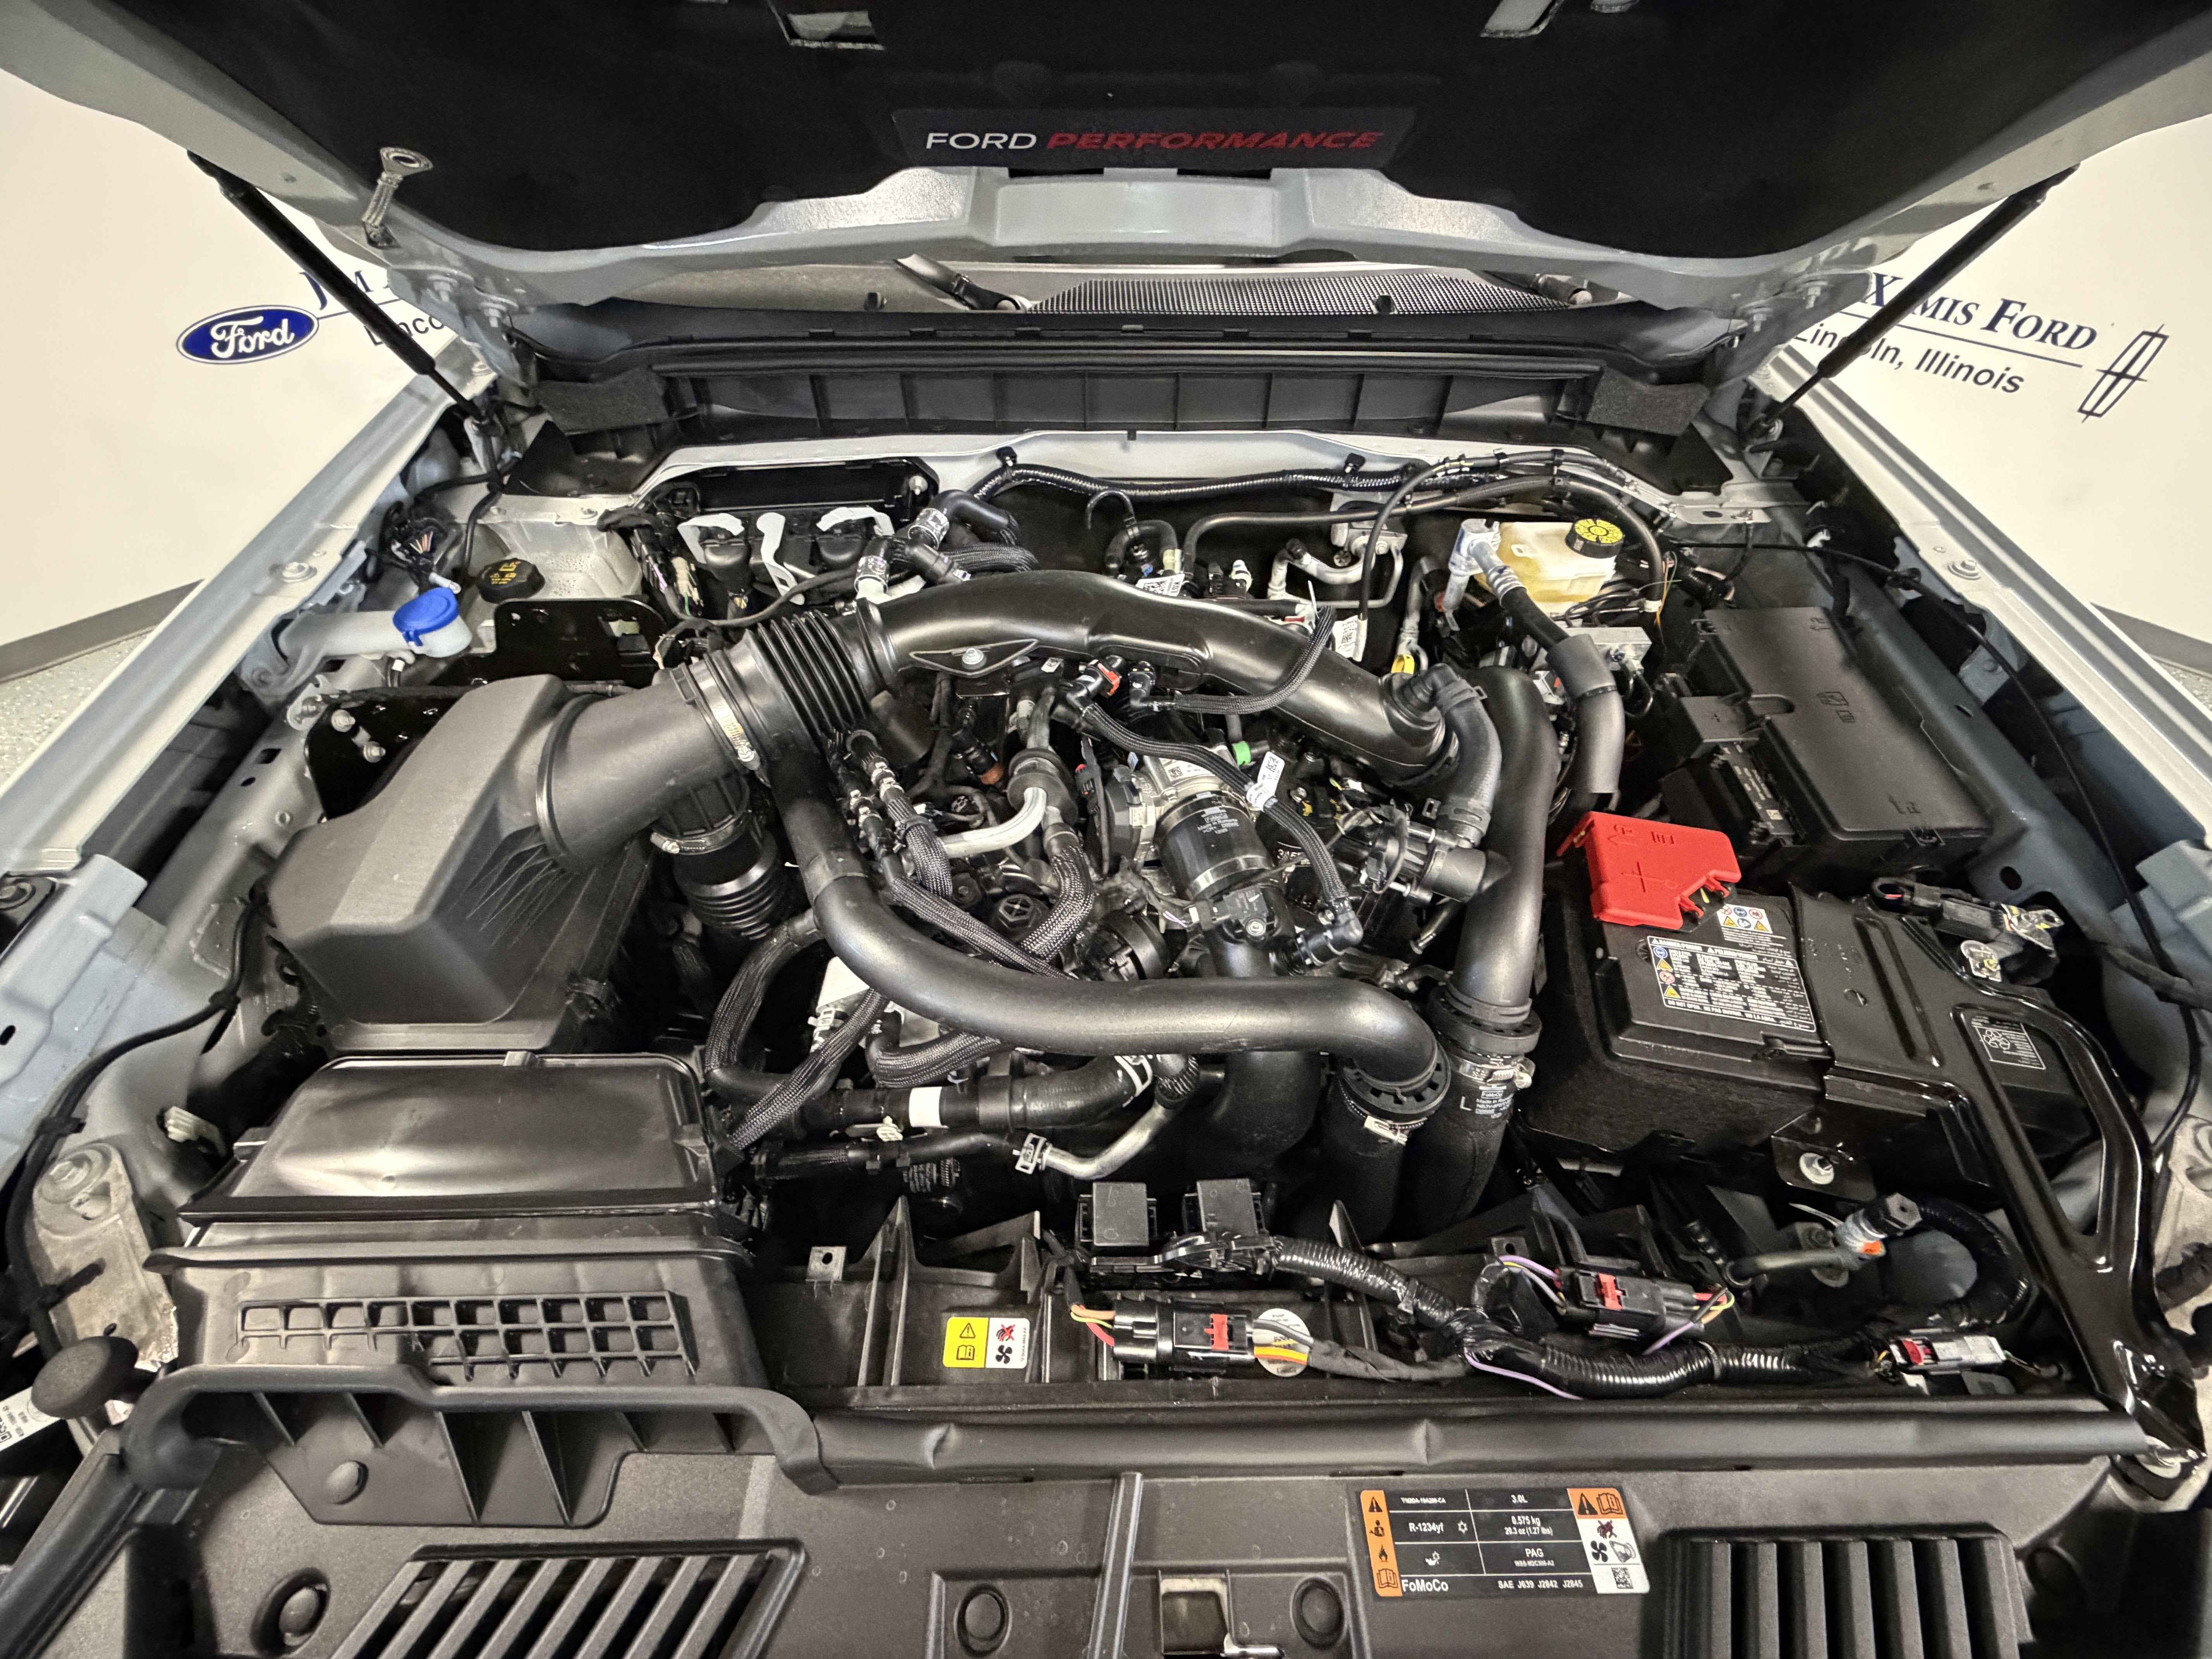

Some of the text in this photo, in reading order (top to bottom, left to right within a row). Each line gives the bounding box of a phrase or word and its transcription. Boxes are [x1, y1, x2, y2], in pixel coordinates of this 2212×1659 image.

[926, 132, 1384, 150] FORD PERFORMANCE
[1859, 272, 1980, 326] XMIS
[210, 316, 295, 359] Ford
[1915, 348, 2024, 393] Illinois
[1460, 1096, 1472, 1111] L
[1511, 1494, 1528, 1503] 3.0L
[1408, 1522, 1444, 1534] R-1234yf
[1511, 1516, 1541, 1527] 0.575 kg
[1525, 1548, 1544, 1558] PAG
[1402, 1579, 1449, 1592] FoMoCo
[1498, 1580, 1515, 1589] SAE
